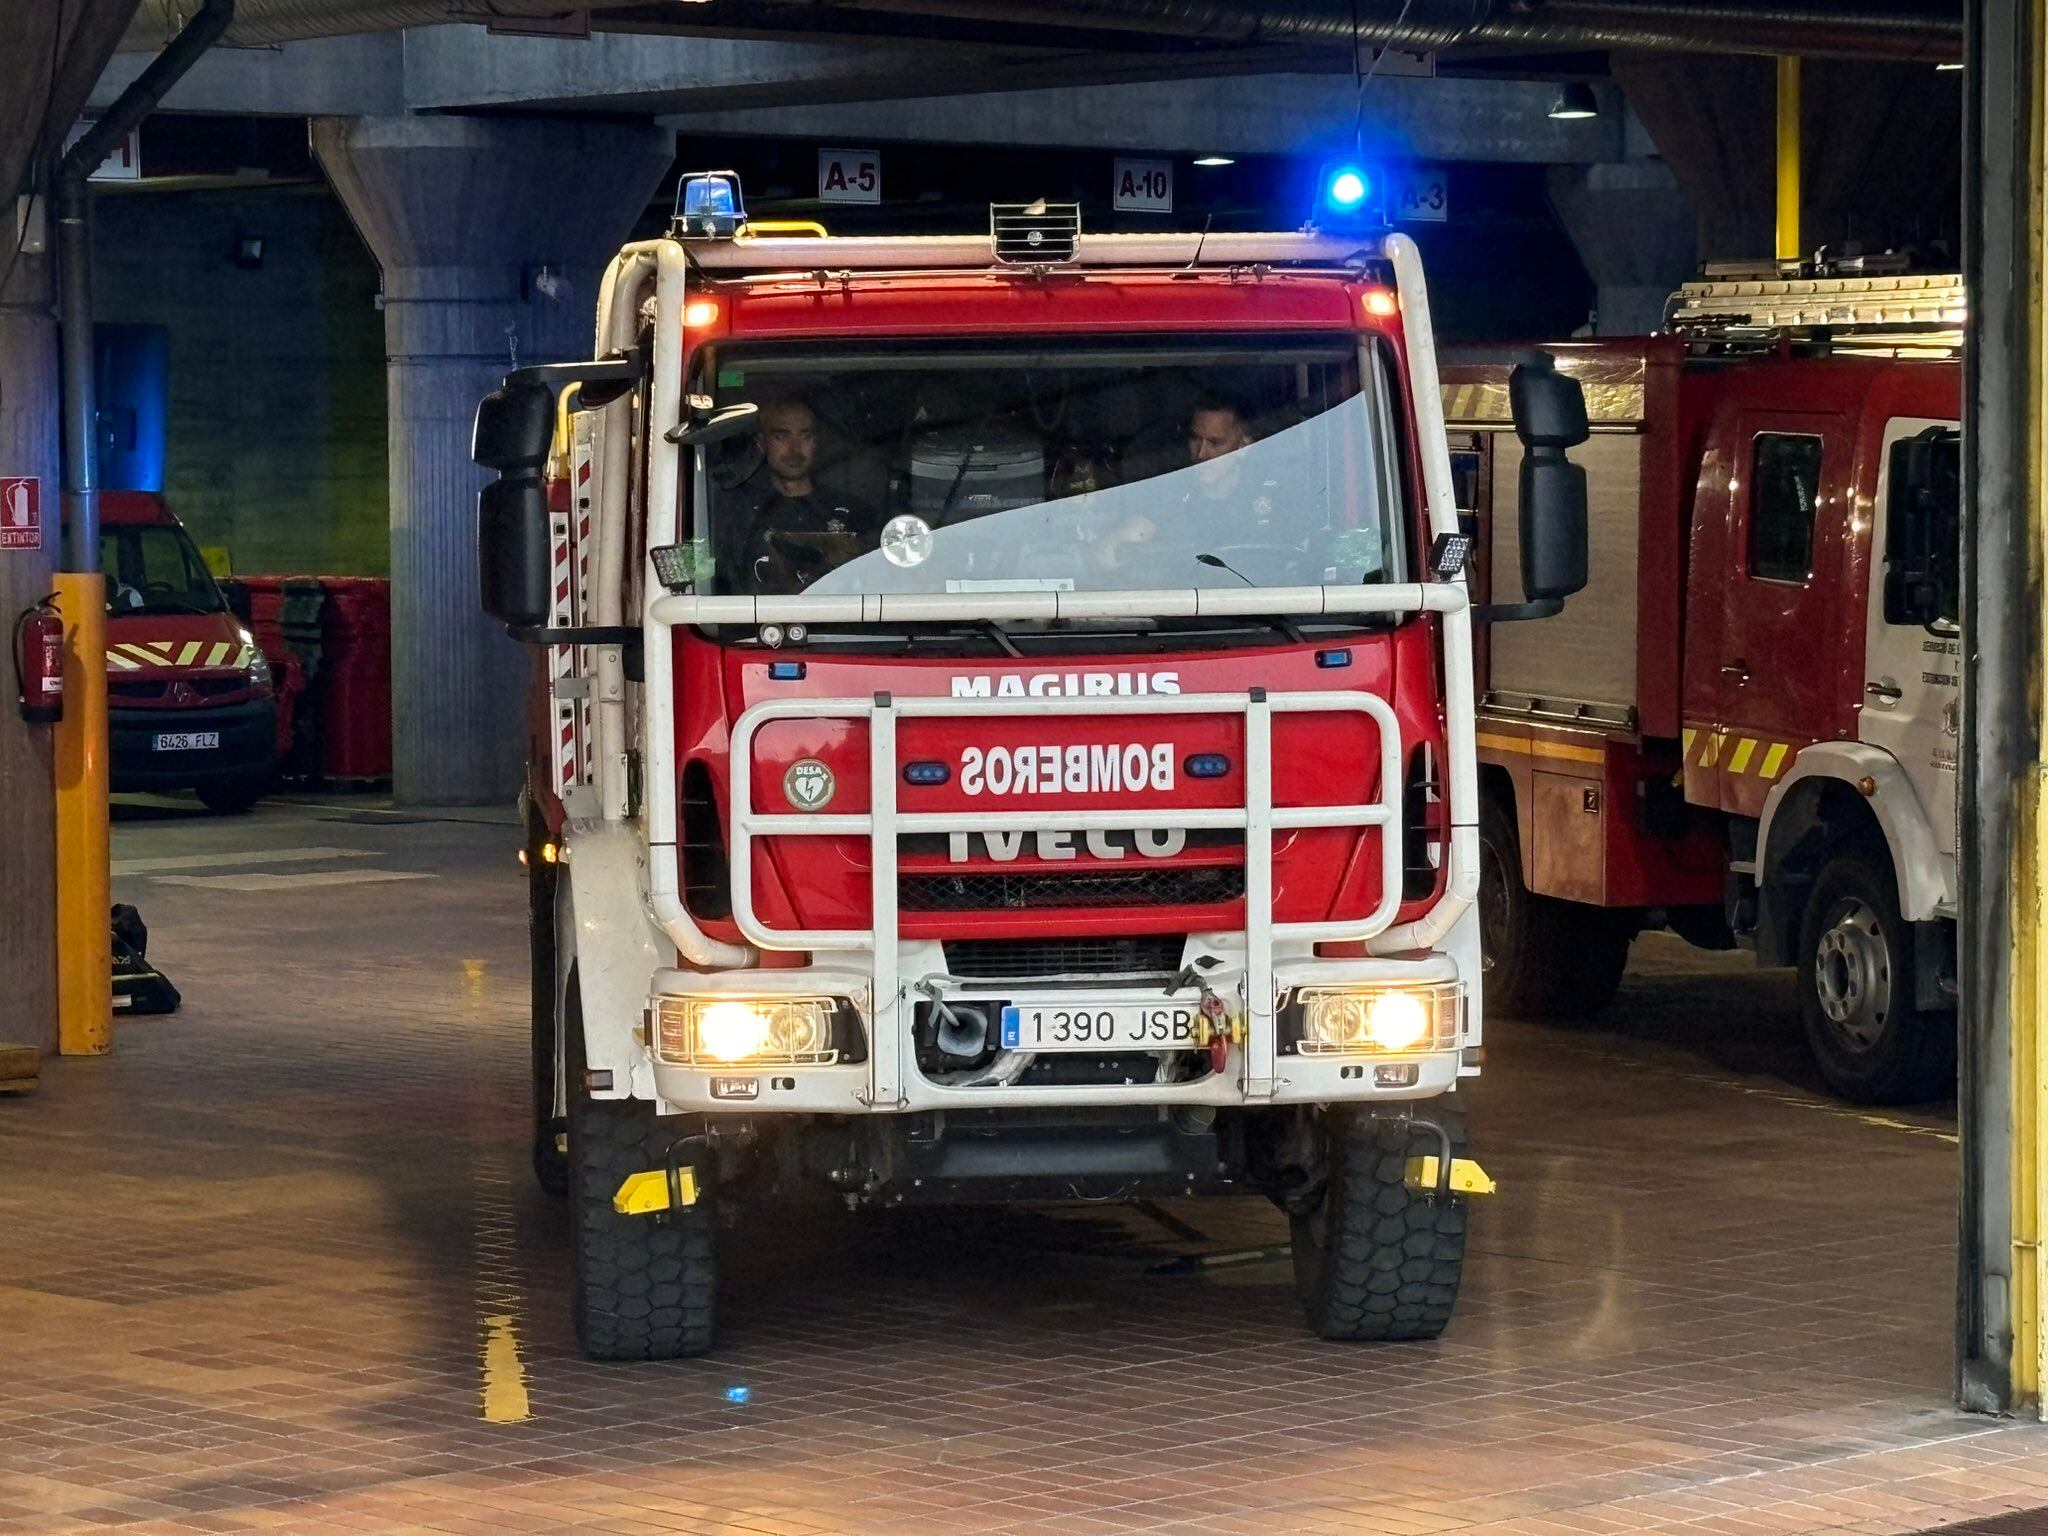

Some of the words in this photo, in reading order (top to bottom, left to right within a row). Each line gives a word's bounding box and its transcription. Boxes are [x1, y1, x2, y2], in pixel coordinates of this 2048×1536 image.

[825, 162, 875, 192] A-5
[1119, 170, 1167, 199] A-10
[951, 672, 1181, 698] MAGIRUS
[160, 735, 189, 749] 6426
[195, 733, 216, 747] FLZ
[1032, 1011, 1114, 1043] 1390
[1129, 1010, 1192, 1042] JSB
